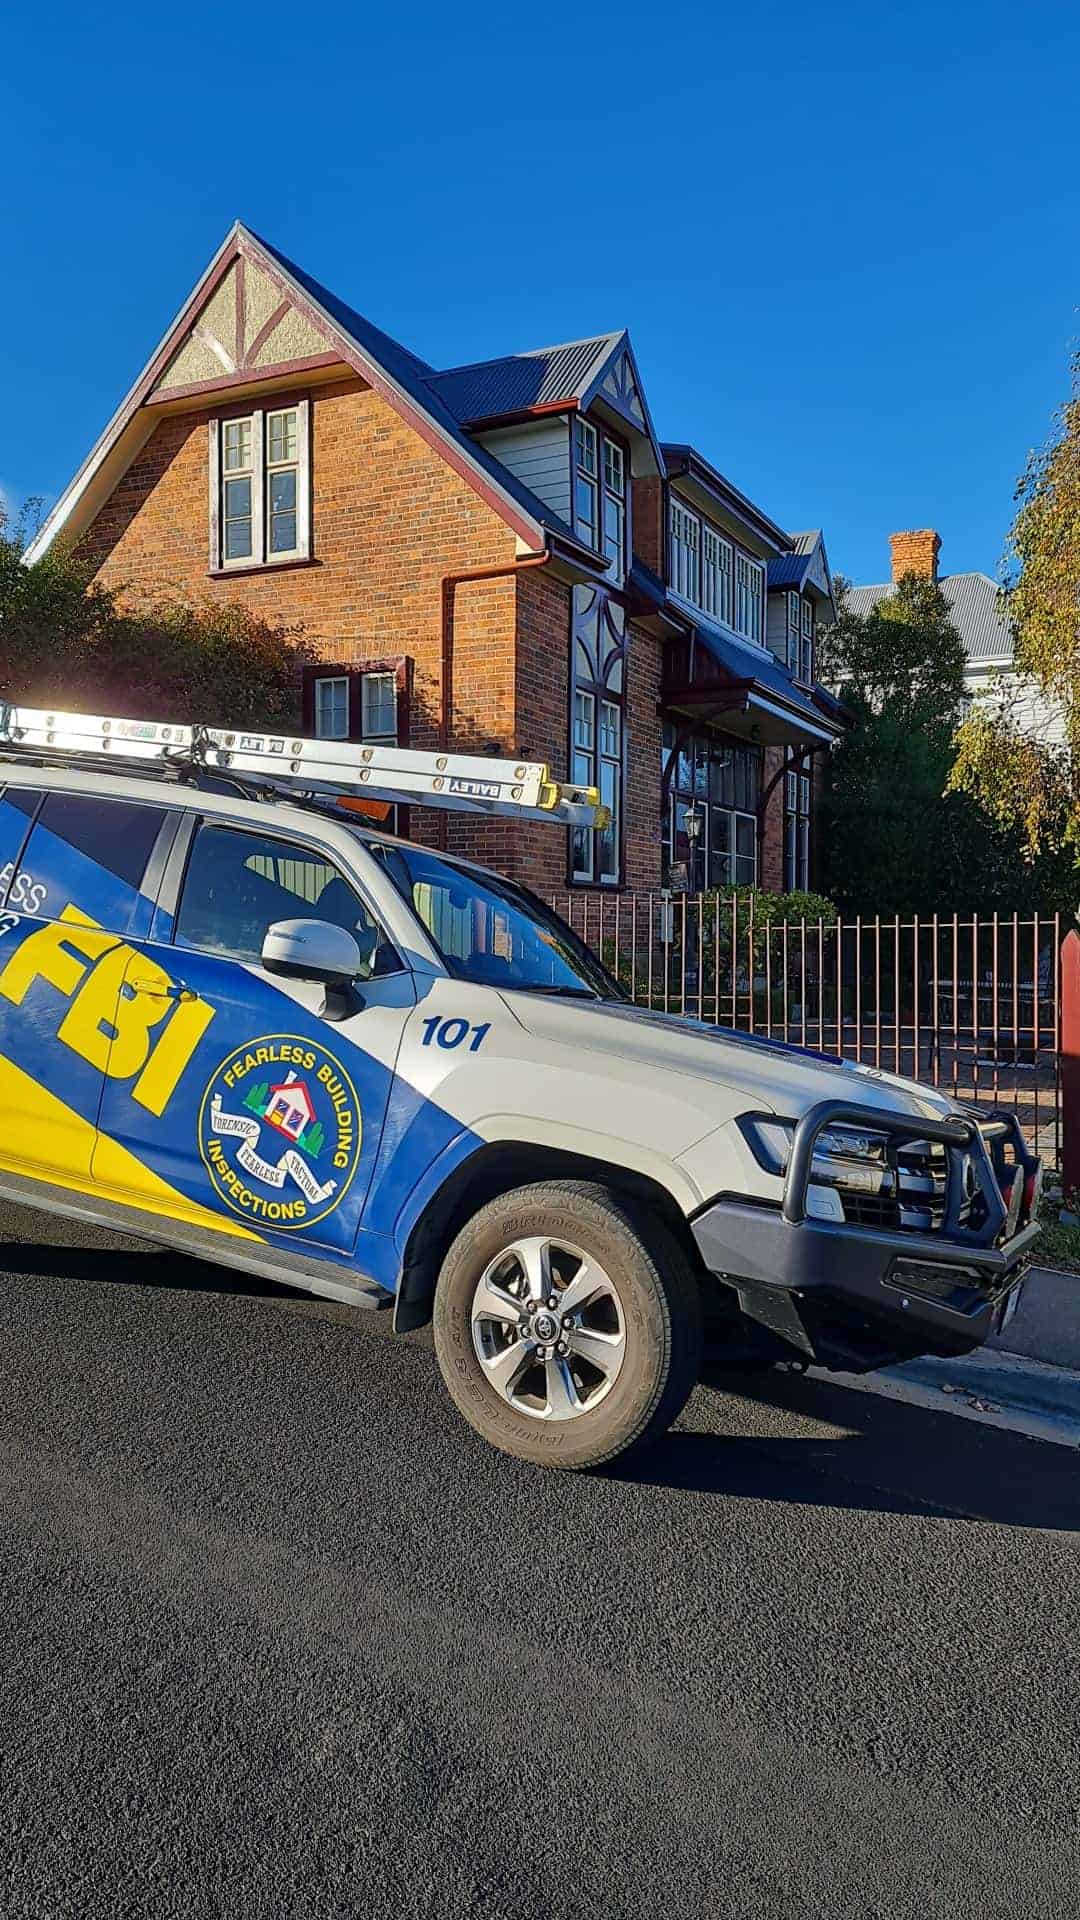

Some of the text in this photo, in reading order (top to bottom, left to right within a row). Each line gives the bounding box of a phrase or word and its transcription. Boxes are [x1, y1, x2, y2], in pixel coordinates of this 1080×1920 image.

[451, 781, 500, 797] BAILEY
[0, 902, 217, 1118] FBI
[422, 1015, 492, 1052] 101
[214, 1116, 257, 1135] FORENSIC
[223, 1045, 353, 1168] FEARLESS BUILDING
[208, 1140, 306, 1219] INSPECTIONS
[240, 1149, 280, 1183] FEARLESS
[291, 1156, 319, 1200] FACTUAL
